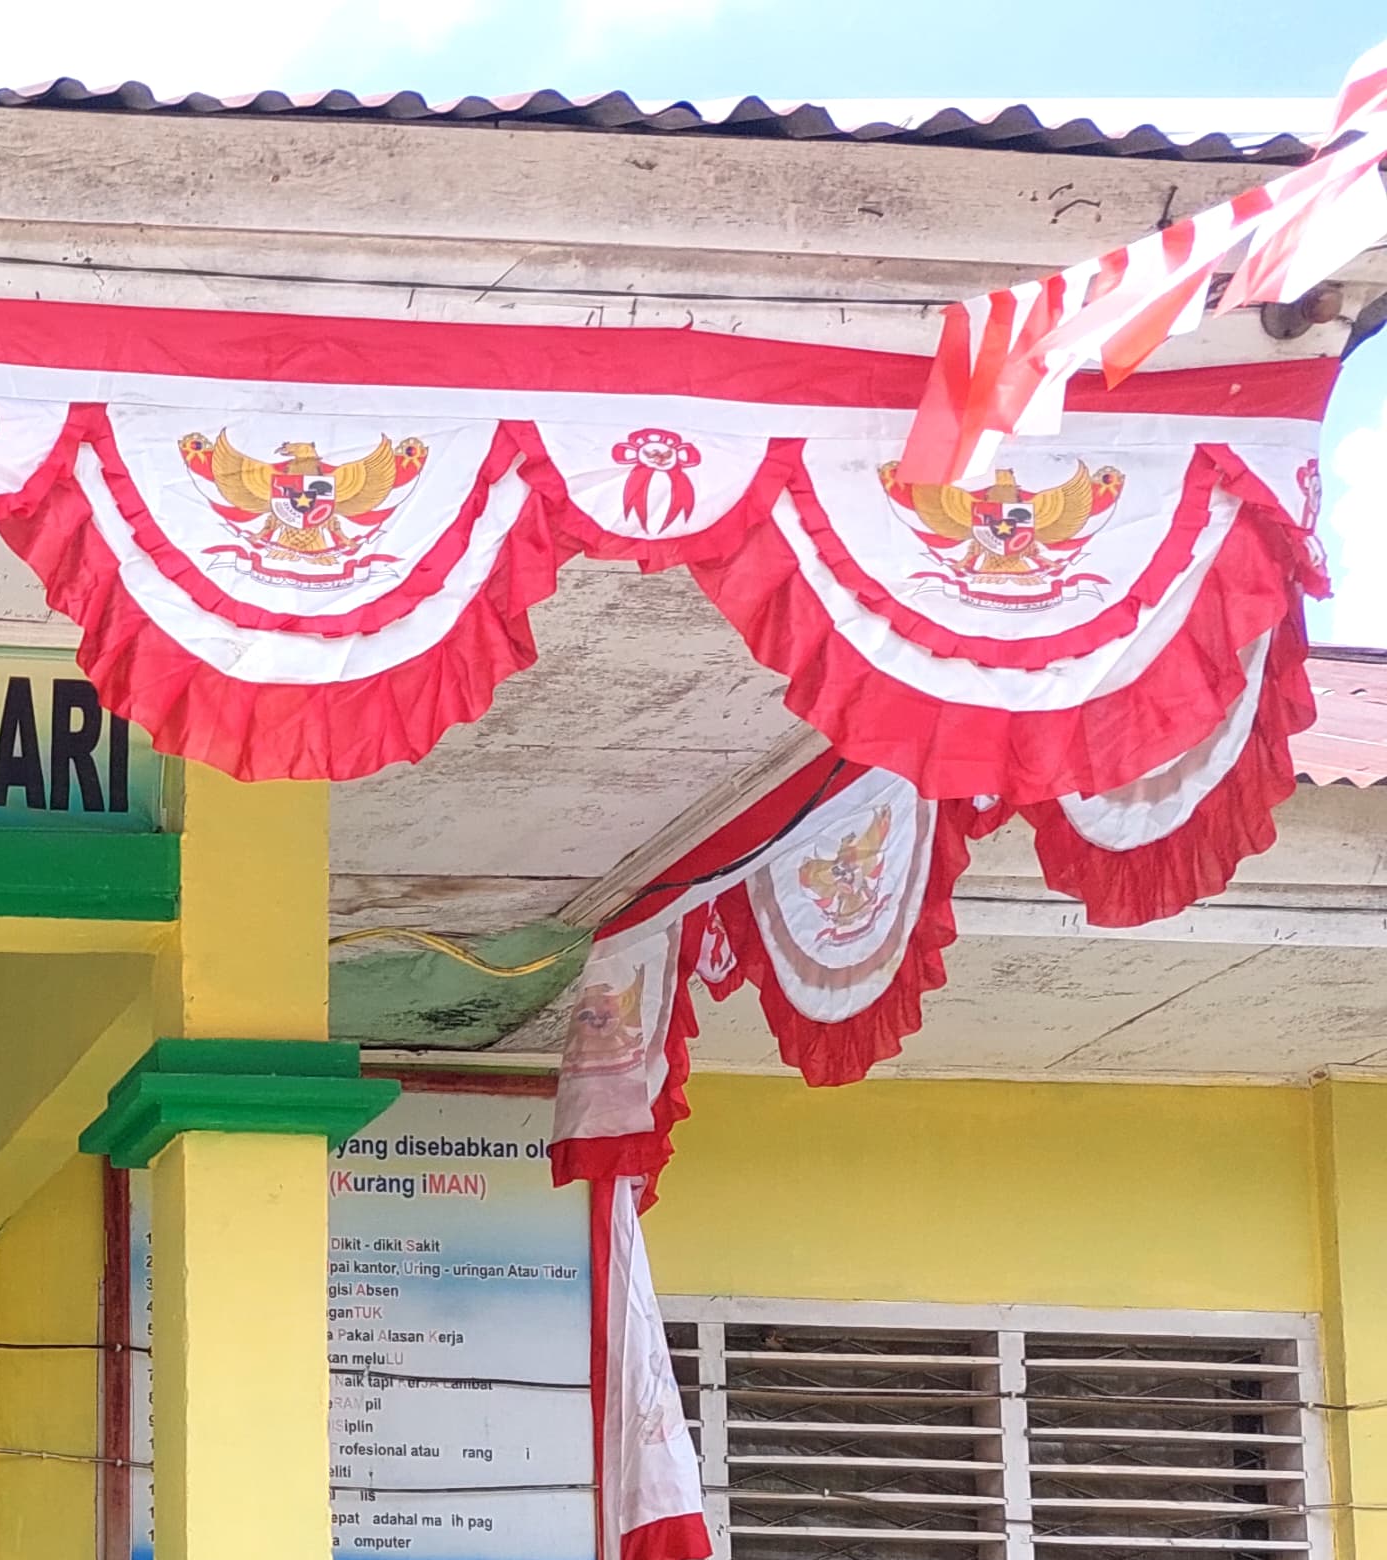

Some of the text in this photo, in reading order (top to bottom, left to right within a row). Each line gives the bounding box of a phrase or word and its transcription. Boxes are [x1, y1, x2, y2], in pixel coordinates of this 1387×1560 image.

[336, 1138, 387, 1159] yang
[395, 1135, 518, 1158] disebabkan
[329, 1170, 487, 1200] (Kurang iMAN)
[373, 1238, 403, 1252] dikit
[406, 1239, 441, 1253] Sakit
[353, 1261, 578, 1279] kantor, Uring uringan Atau Tidur
[356, 1284, 399, 1297] Absen
[378, 1330, 424, 1343] Alasan
[428, 1330, 464, 1347] Kerja
[410, 1444, 440, 1458] atau
